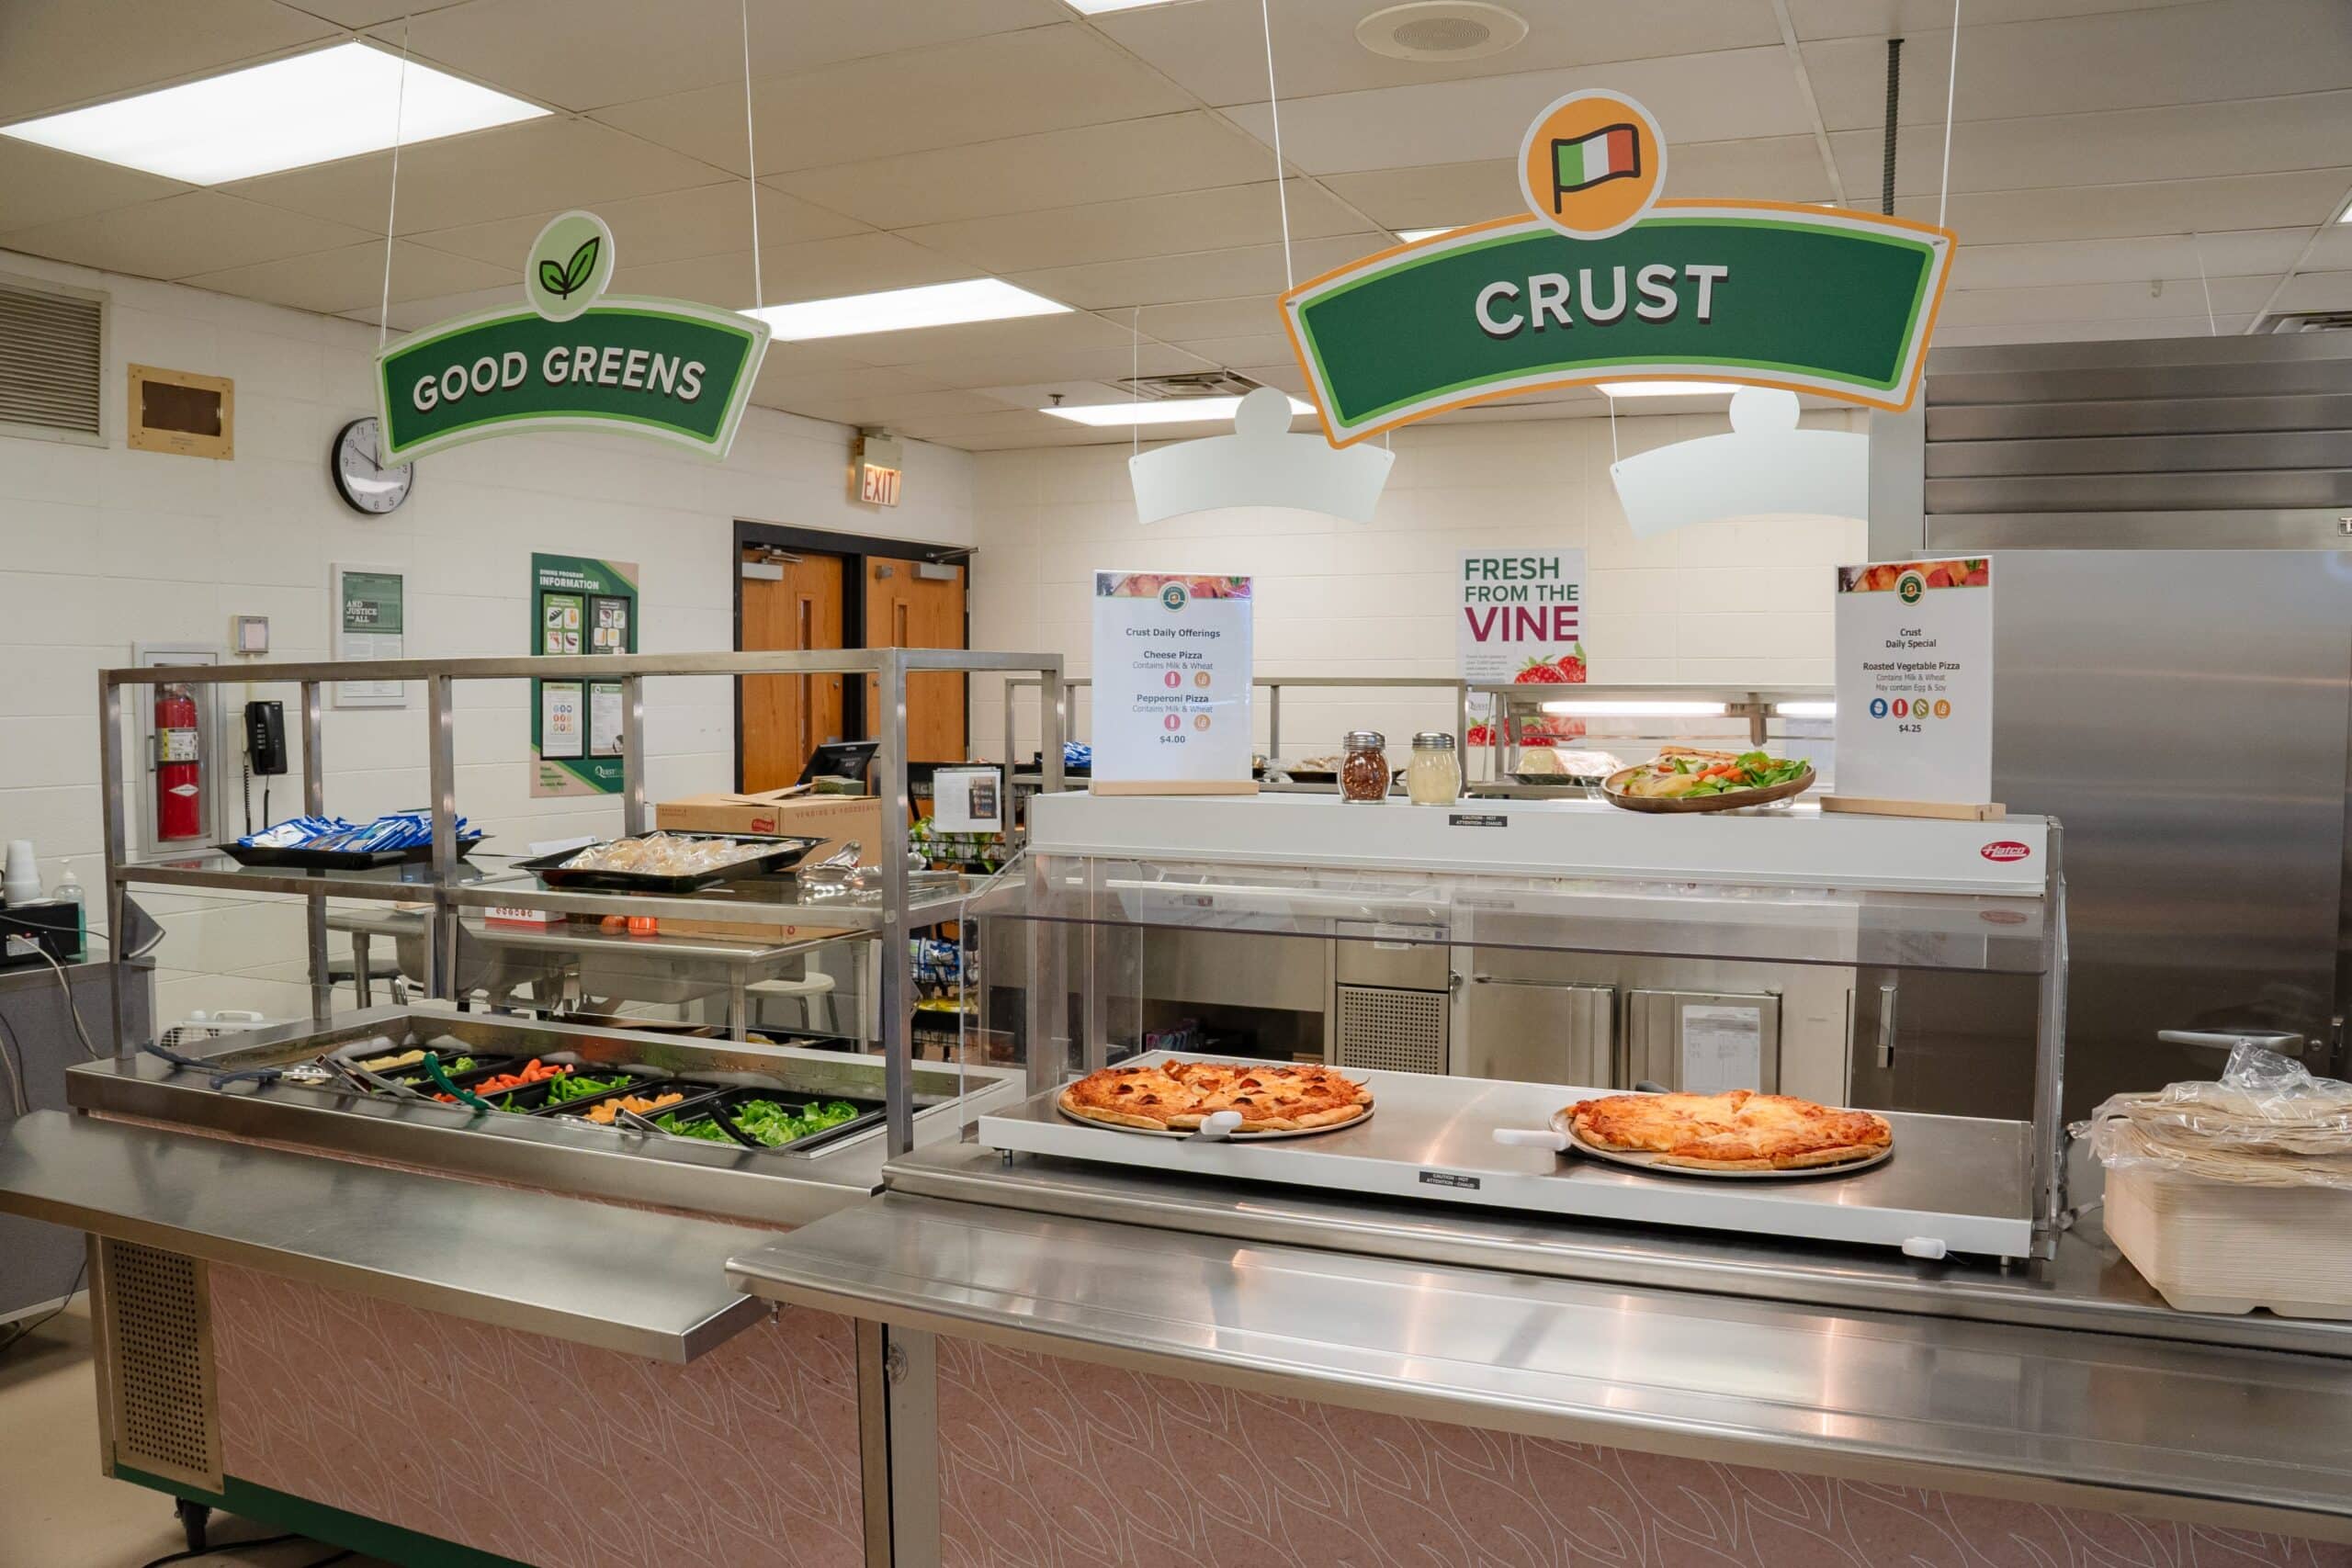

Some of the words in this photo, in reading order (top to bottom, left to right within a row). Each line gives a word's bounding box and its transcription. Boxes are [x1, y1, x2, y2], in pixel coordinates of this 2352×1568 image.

[1476, 264, 1729, 338] CRUST
[413, 351, 528, 412] GOOD
[542, 345, 706, 400] GREENS
[356, 425, 365, 435] 11
[345, 439, 356, 449] 10
[864, 467, 895, 504] EXIT
[374, 500, 379, 510] 6
[389, 497, 395, 507] 5
[1464, 557, 1559, 581] FRESH
[559, 570, 584, 579] PROGRAM
[539, 575, 599, 590] INFORMATION
[1464, 585, 1528, 603] FROM
[1535, 584, 1579, 602] THE
[345, 599, 364, 608] AND
[345, 607, 378, 616] JUSTICE
[355, 615, 370, 624] ALL
[1464, 605, 1579, 642] VINE
[1125, 627, 1151, 637] Crust
[1153, 628, 1176, 638] Daily
[1178, 628, 1221, 638] Offerings
[1900, 628, 1922, 637] Crust
[1885, 639, 1906, 649] Daily
[1907, 639, 1937, 649] Special
[1143, 650, 1177, 660] Cheese
[1179, 651, 1203, 660] Pizza
[1132, 661, 1164, 670] Contains
[1166, 661, 1181, 670] Milk
[1190, 661, 1213, 670] Wheat
[1863, 662, 1895, 671] Roasted
[1896, 662, 1937, 671] Vegetable
[1939, 661, 1961, 671] Pizza
[1876, 673, 1903, 682] Contains
[1905, 673, 1917, 682] Milk
[1925, 673, 1946, 682] Wheat
[1875, 684, 1888, 693] May
[1889, 683, 1913, 692] contain
[1913, 684, 1926, 693] Egg
[1934, 684, 1947, 693] Soy
[1136, 694, 1183, 705] Pepperoni
[1185, 694, 1209, 703] Pizza
[1132, 705, 1164, 713] Contains
[1165, 705, 1180, 713] Milk
[1190, 705, 1213, 714] Wheat
[1898, 724, 1922, 733] $4.25
[1159, 735, 1186, 744] $4.00
[1983, 844, 2027, 858] Hatco
